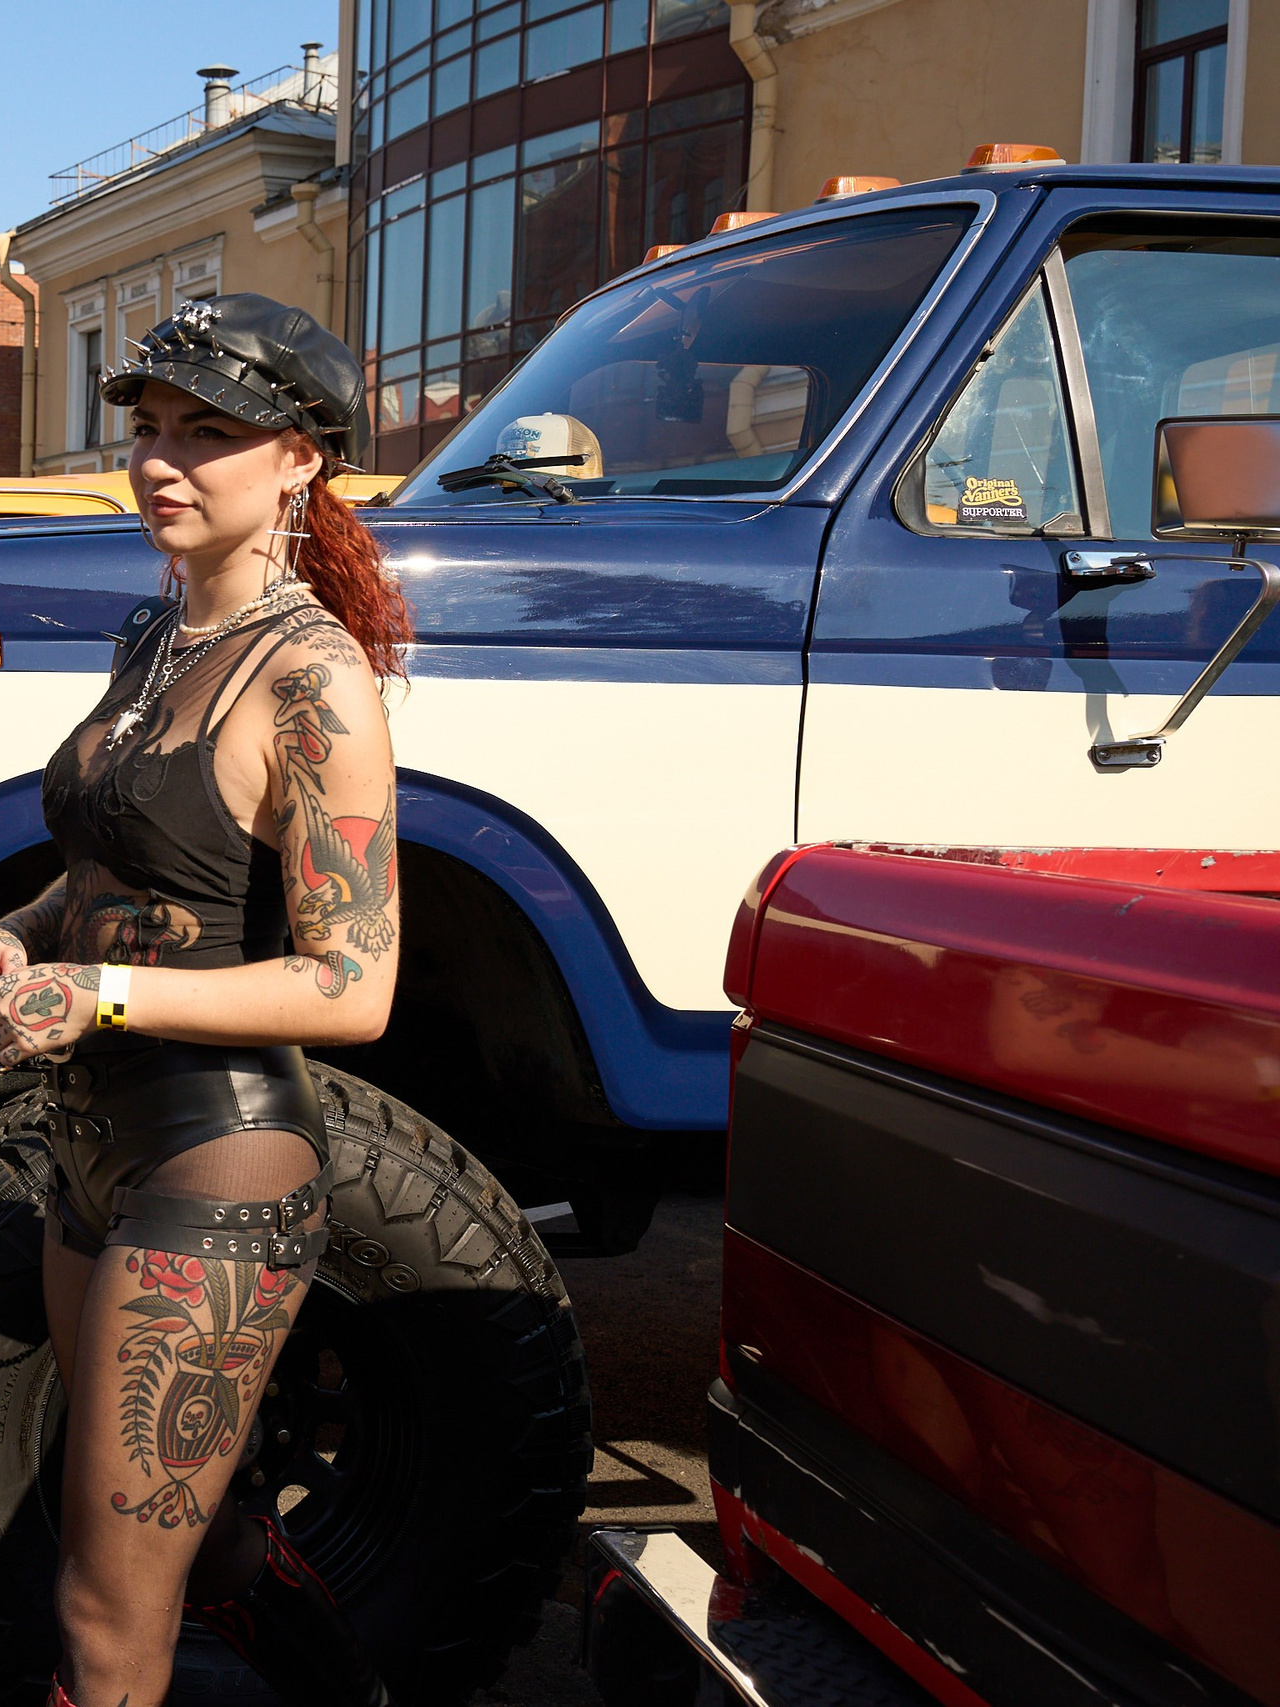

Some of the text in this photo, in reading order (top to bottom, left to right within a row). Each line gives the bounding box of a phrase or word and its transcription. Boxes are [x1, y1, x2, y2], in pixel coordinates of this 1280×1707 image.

[966, 476, 1015, 491] Original
[964, 485, 1019, 502] Vanners
[962, 507, 1025, 518] SUPPORTER
